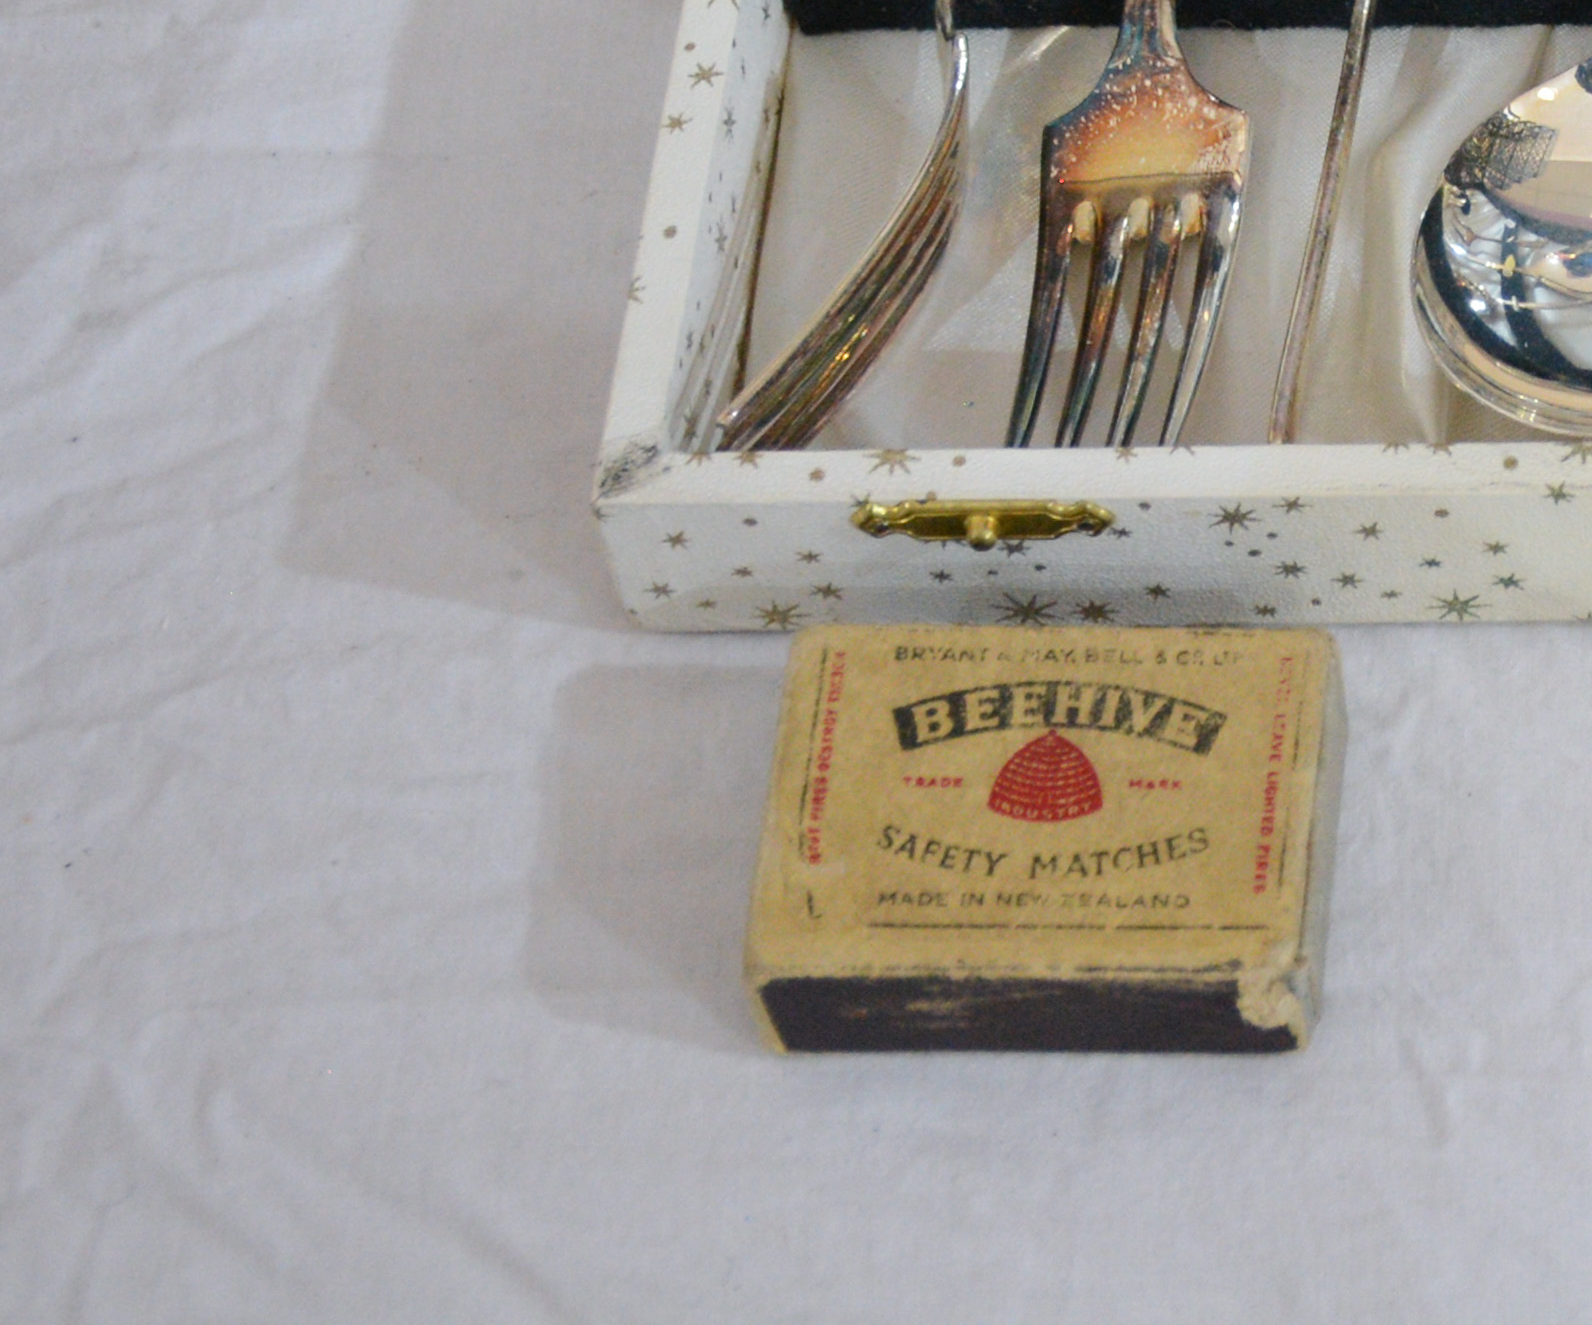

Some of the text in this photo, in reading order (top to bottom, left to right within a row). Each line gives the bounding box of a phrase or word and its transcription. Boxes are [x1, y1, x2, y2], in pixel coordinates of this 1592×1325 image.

[1156, 649, 1168, 665] &
[902, 681, 1214, 755] BEEHIVE
[1269, 712, 1288, 763] LEAVE
[903, 776, 1183, 791] TRADE MARK
[1260, 770, 1281, 838] LIGHTED
[993, 800, 1094, 822] INDUSTRY
[876, 824, 1210, 880] SAFETY MATCHES
[1253, 843, 1272, 895] FIRES
[877, 892, 1191, 909] MADE IN NEW ZEALAND
